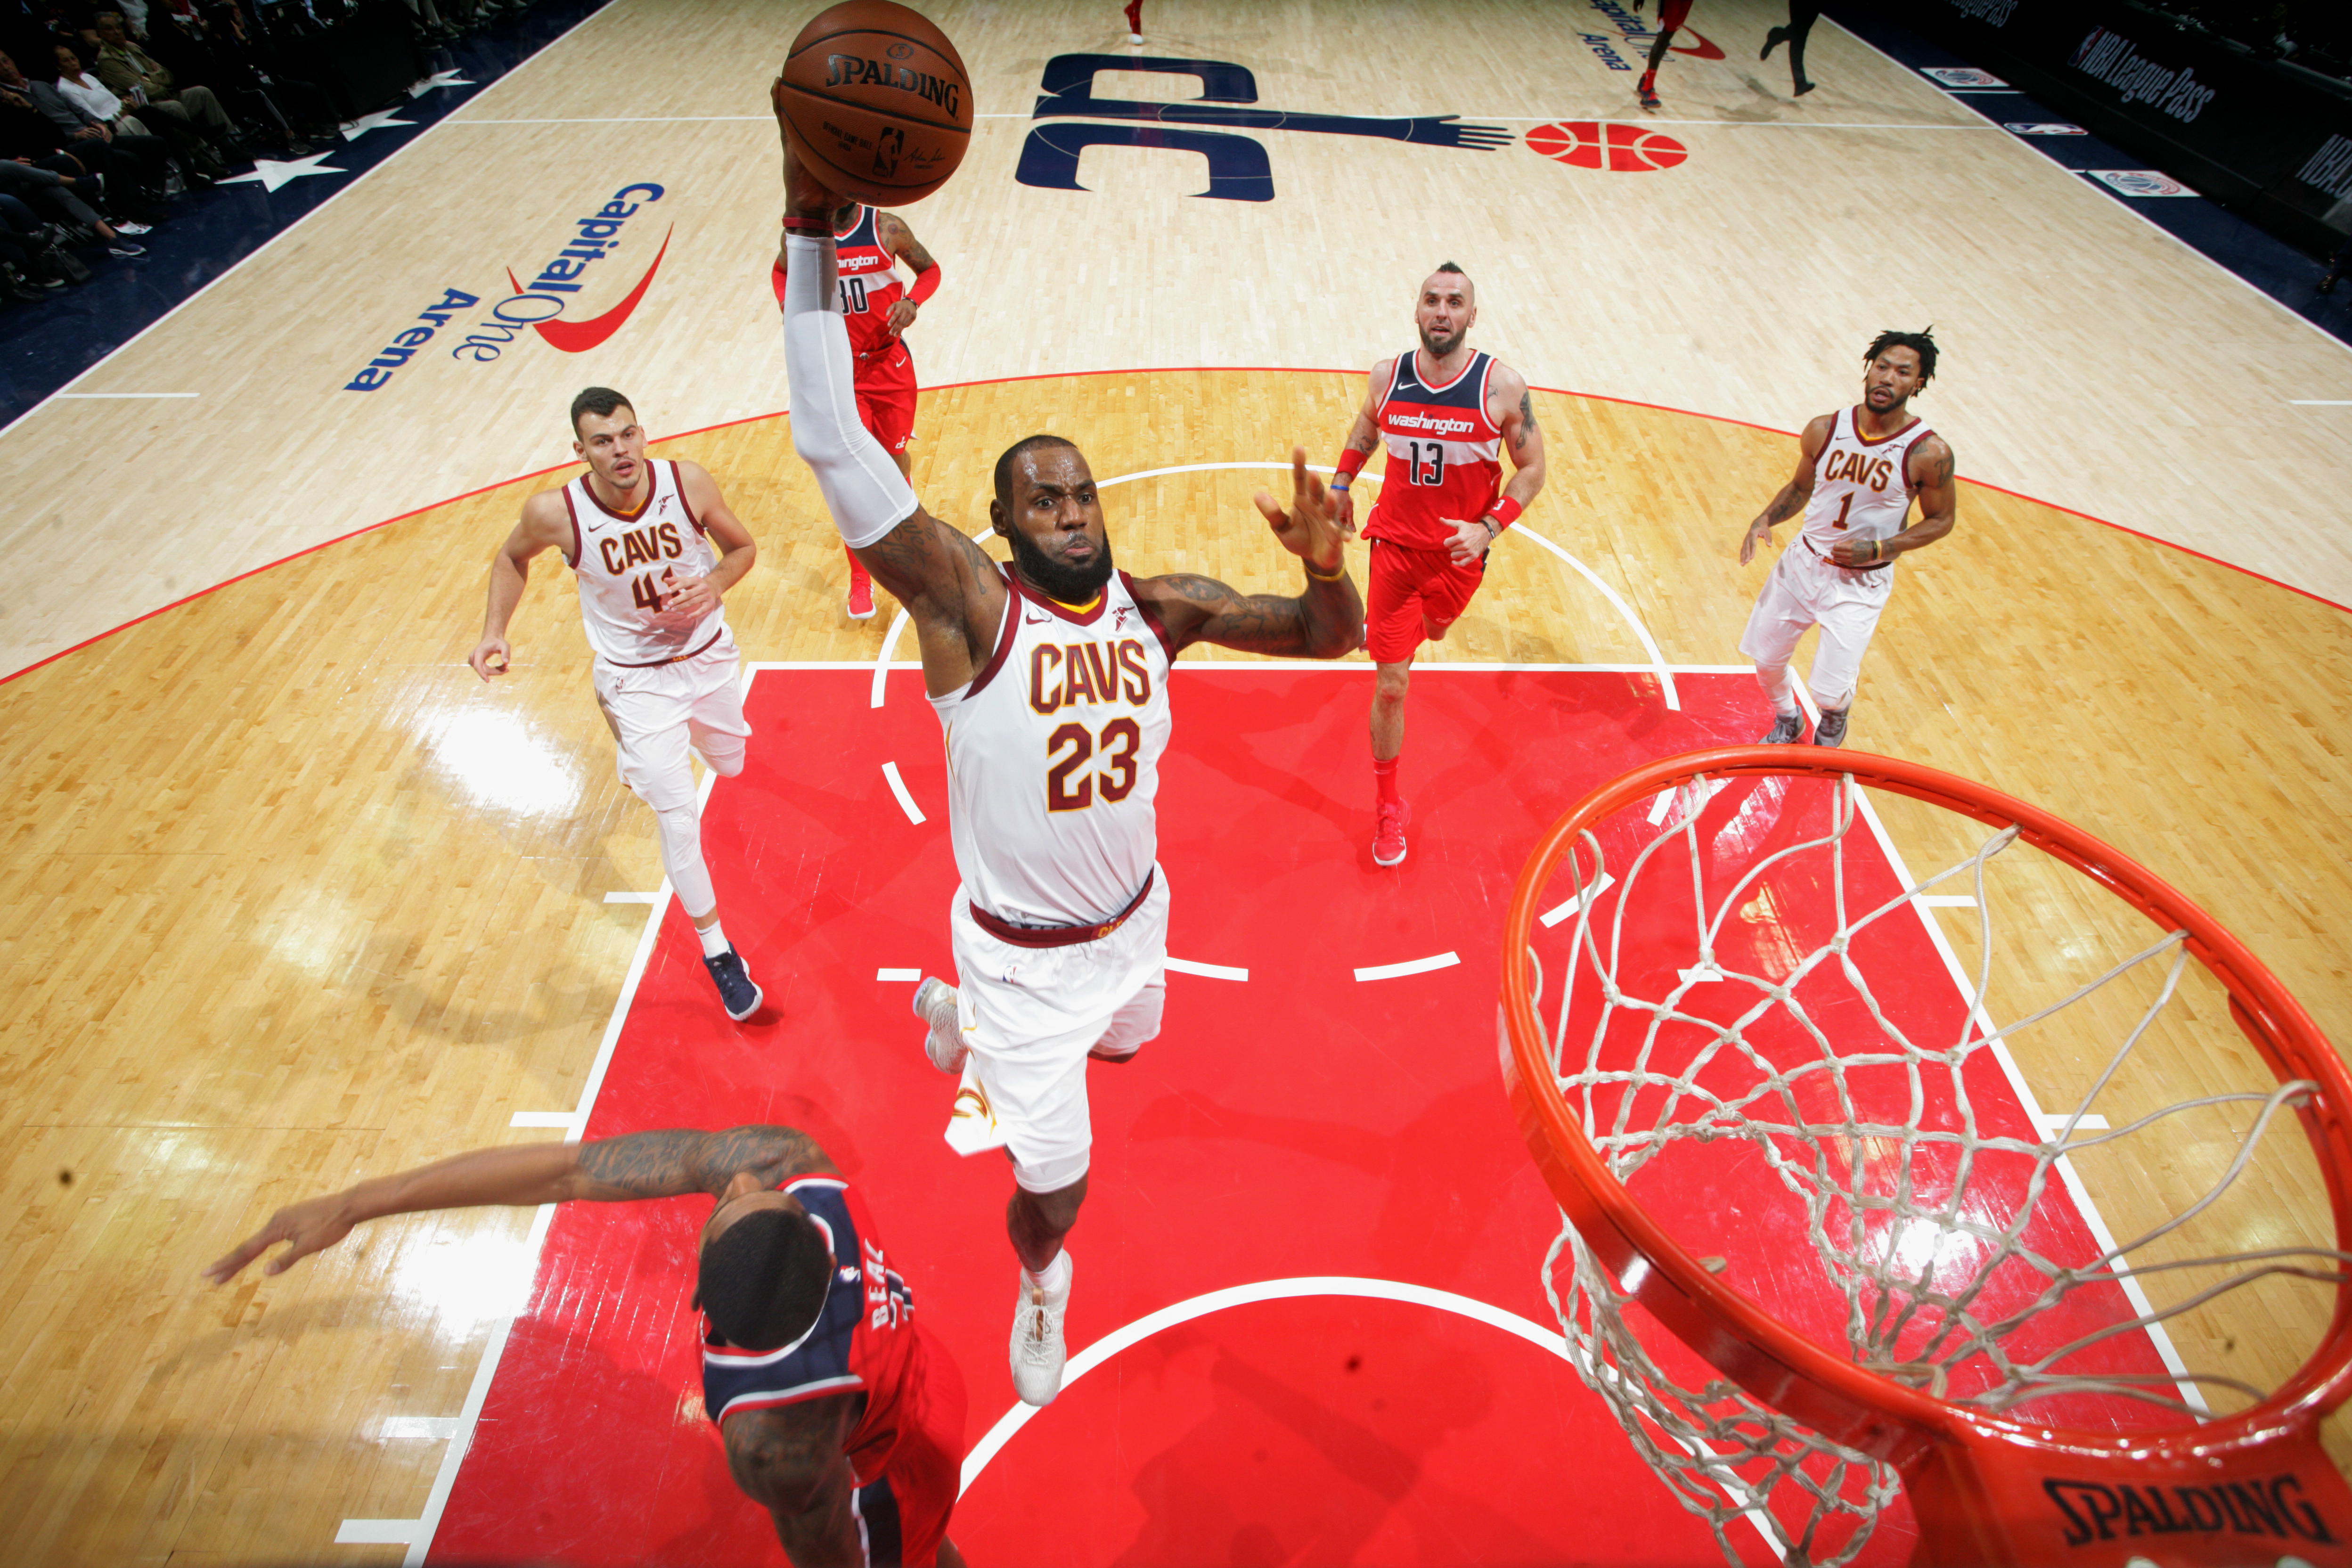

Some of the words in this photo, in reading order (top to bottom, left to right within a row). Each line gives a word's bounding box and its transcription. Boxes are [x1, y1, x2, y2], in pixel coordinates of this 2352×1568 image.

[1577, 32, 1632, 71] Arena
[2078, 30, 2130, 80] NBA
[2104, 43, 2175, 103] League
[2155, 67, 2216, 123] Pass
[826, 53, 958, 121] SPALDING
[343, 288, 480, 392] Arena
[1388, 411, 1474, 435] washington
[1409, 441, 1444, 486] 13
[1824, 449, 1893, 492] CAVS
[1832, 491, 1855, 531] 1
[599, 522, 683, 576] CAVS
[1029, 638, 1151, 716] CAVS
[1047, 716, 1141, 813] 23
[864, 1238, 889, 1331] BEAL
[2042, 1473, 2342, 1547] SPALDING
